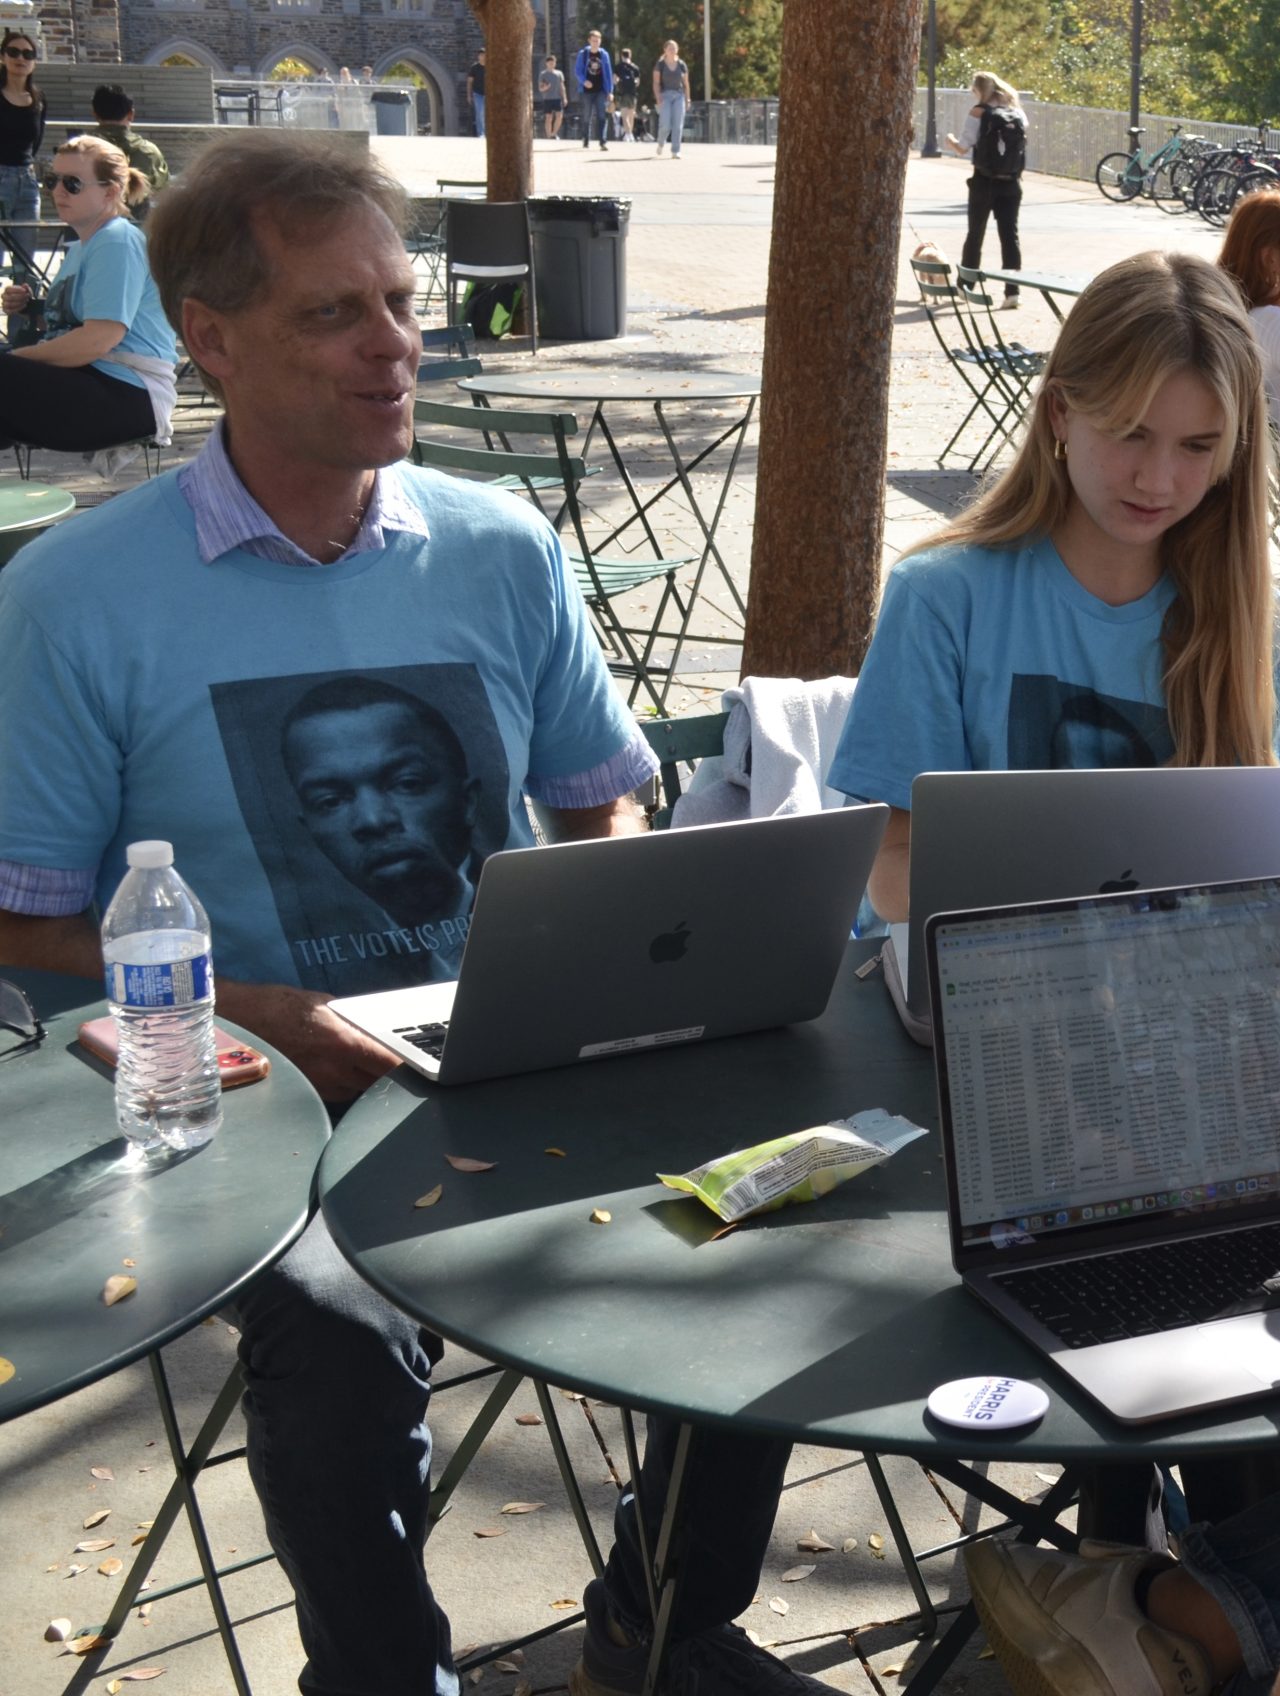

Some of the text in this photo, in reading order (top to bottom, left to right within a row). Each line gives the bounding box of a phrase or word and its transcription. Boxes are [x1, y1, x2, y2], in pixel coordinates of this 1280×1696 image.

[295, 913, 474, 967] THE VOTE IS PR
[974, 1379, 1017, 1420] HARRIS
